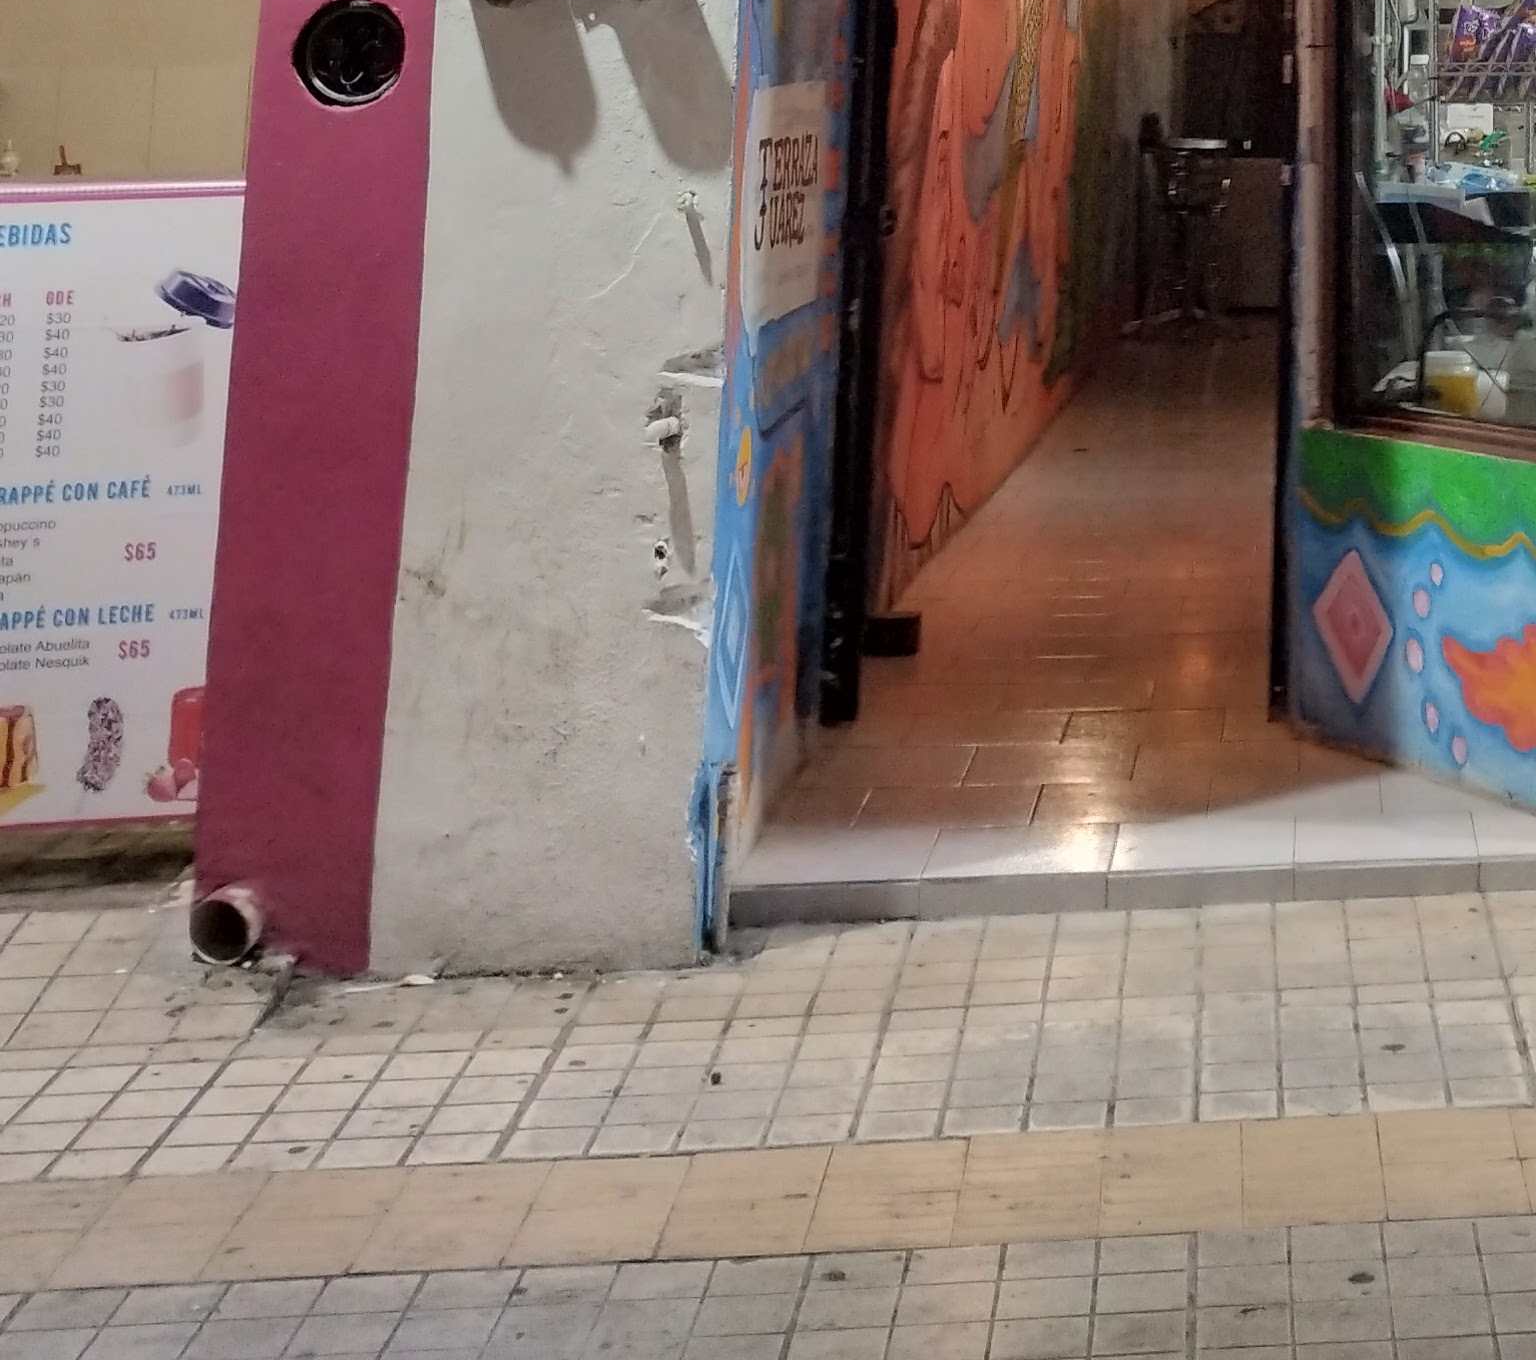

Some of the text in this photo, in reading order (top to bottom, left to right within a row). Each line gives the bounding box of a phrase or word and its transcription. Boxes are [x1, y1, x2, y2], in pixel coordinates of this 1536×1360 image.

[758, 130, 819, 191] TERRAZA
[754, 190, 807, 251] JUAREZ
[46, 312, 71, 325] $30
[45, 328, 70, 341] $40
[43, 346, 68, 359] $40
[42, 363, 67, 376] $40
[40, 380, 65, 393] $30
[39, 395, 64, 408] $30
[37, 413, 62, 426] $40
[36, 429, 61, 442] $40
[35, 445, 60, 458] $40
[62, 483, 99, 502] CON
[107, 475, 151, 499] CAFÉ
[124, 542, 157, 562] $65
[53, 607, 90, 627] CON
[98, 603, 155, 625] LECHE
[35, 638, 90, 652] Abuelita
[118, 639, 150, 660] $65
[36, 656, 89, 671] Nesquik
